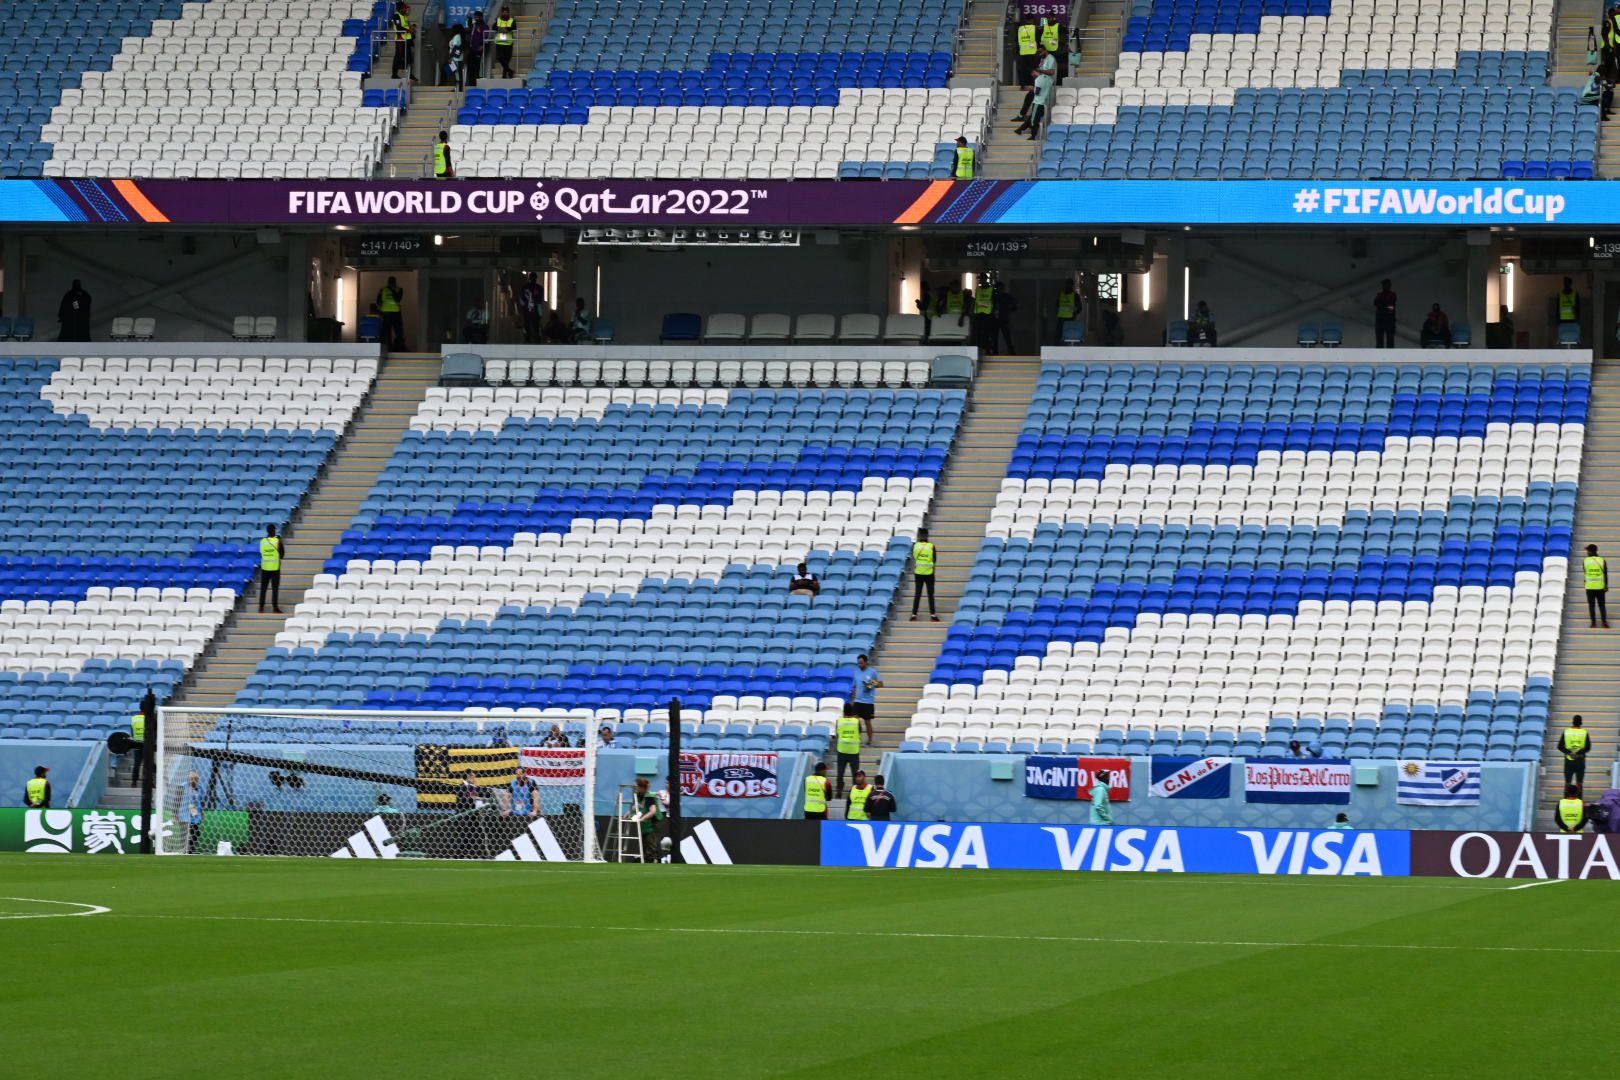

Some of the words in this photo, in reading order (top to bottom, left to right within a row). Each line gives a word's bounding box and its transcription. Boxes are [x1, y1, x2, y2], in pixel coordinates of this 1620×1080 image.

[289, 191, 352, 214] FIFA
[354, 190, 463, 214] WORLD
[467, 190, 525, 213] CUP
[1292, 187, 1565, 221] #FIFAWorldCup
[708, 778, 778, 796] GOES
[1090, 768, 1129, 788] VRA
[846, 823, 989, 868] VISA
[1040, 827, 1185, 872] VISA
[1236, 830, 1383, 876] VISA
